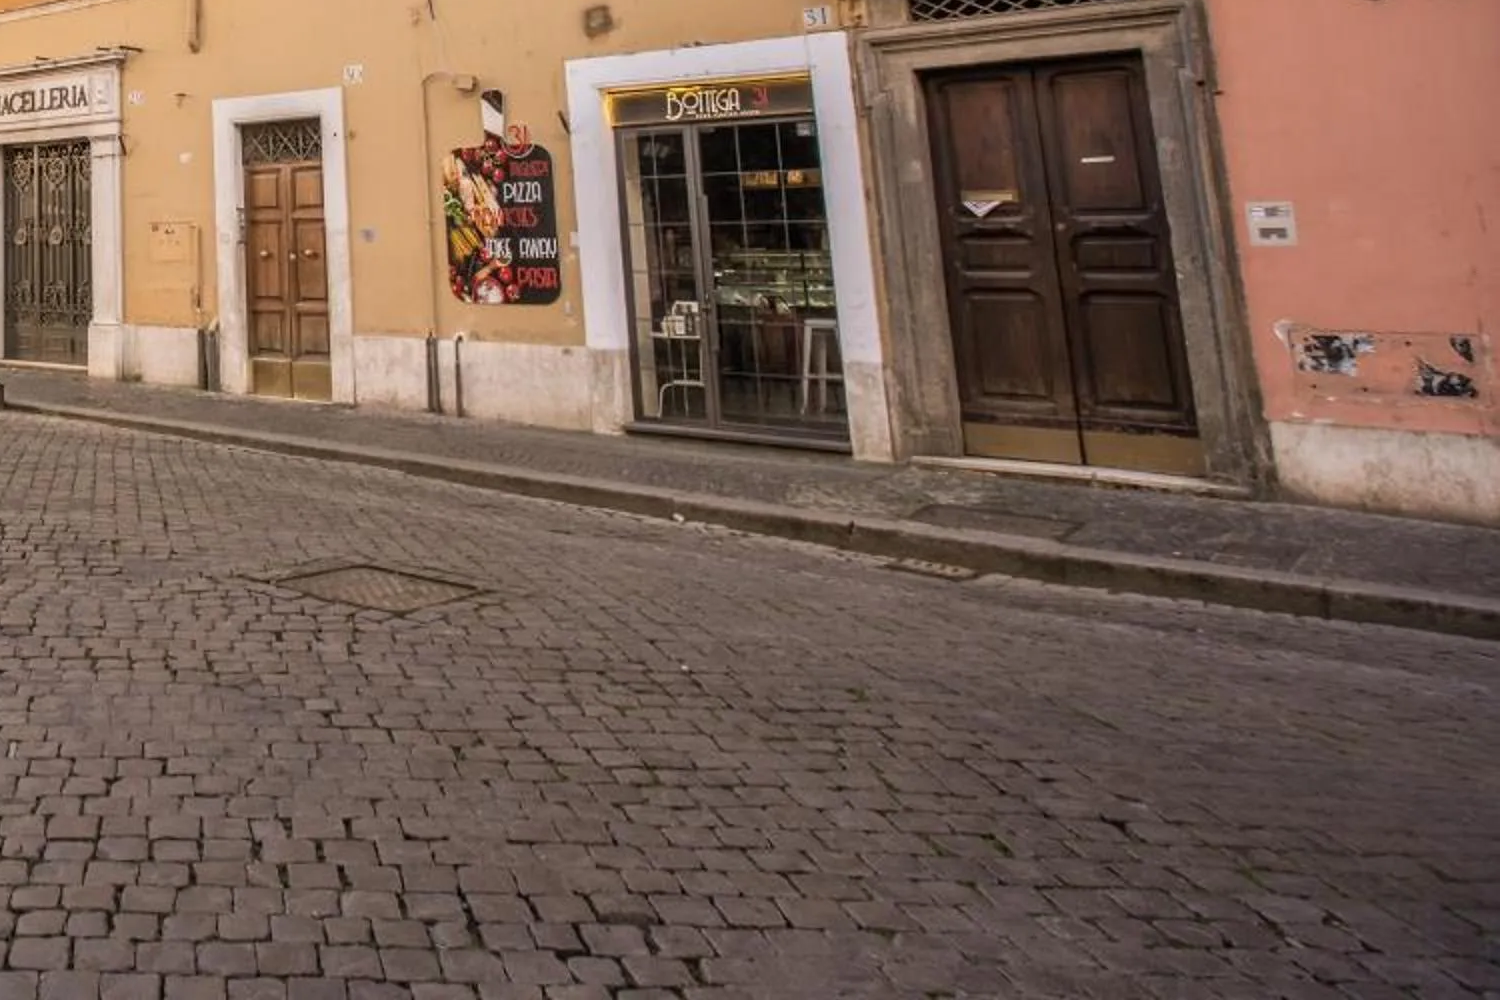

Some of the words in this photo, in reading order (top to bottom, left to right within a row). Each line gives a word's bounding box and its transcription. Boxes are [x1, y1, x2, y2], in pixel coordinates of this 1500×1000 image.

[507, 122, 531, 151] 31
[503, 181, 542, 204] PIZZA
[485, 237, 512, 261] TAKE
[519, 237, 557, 259] AWAY
[517, 266, 557, 289] PASTA
